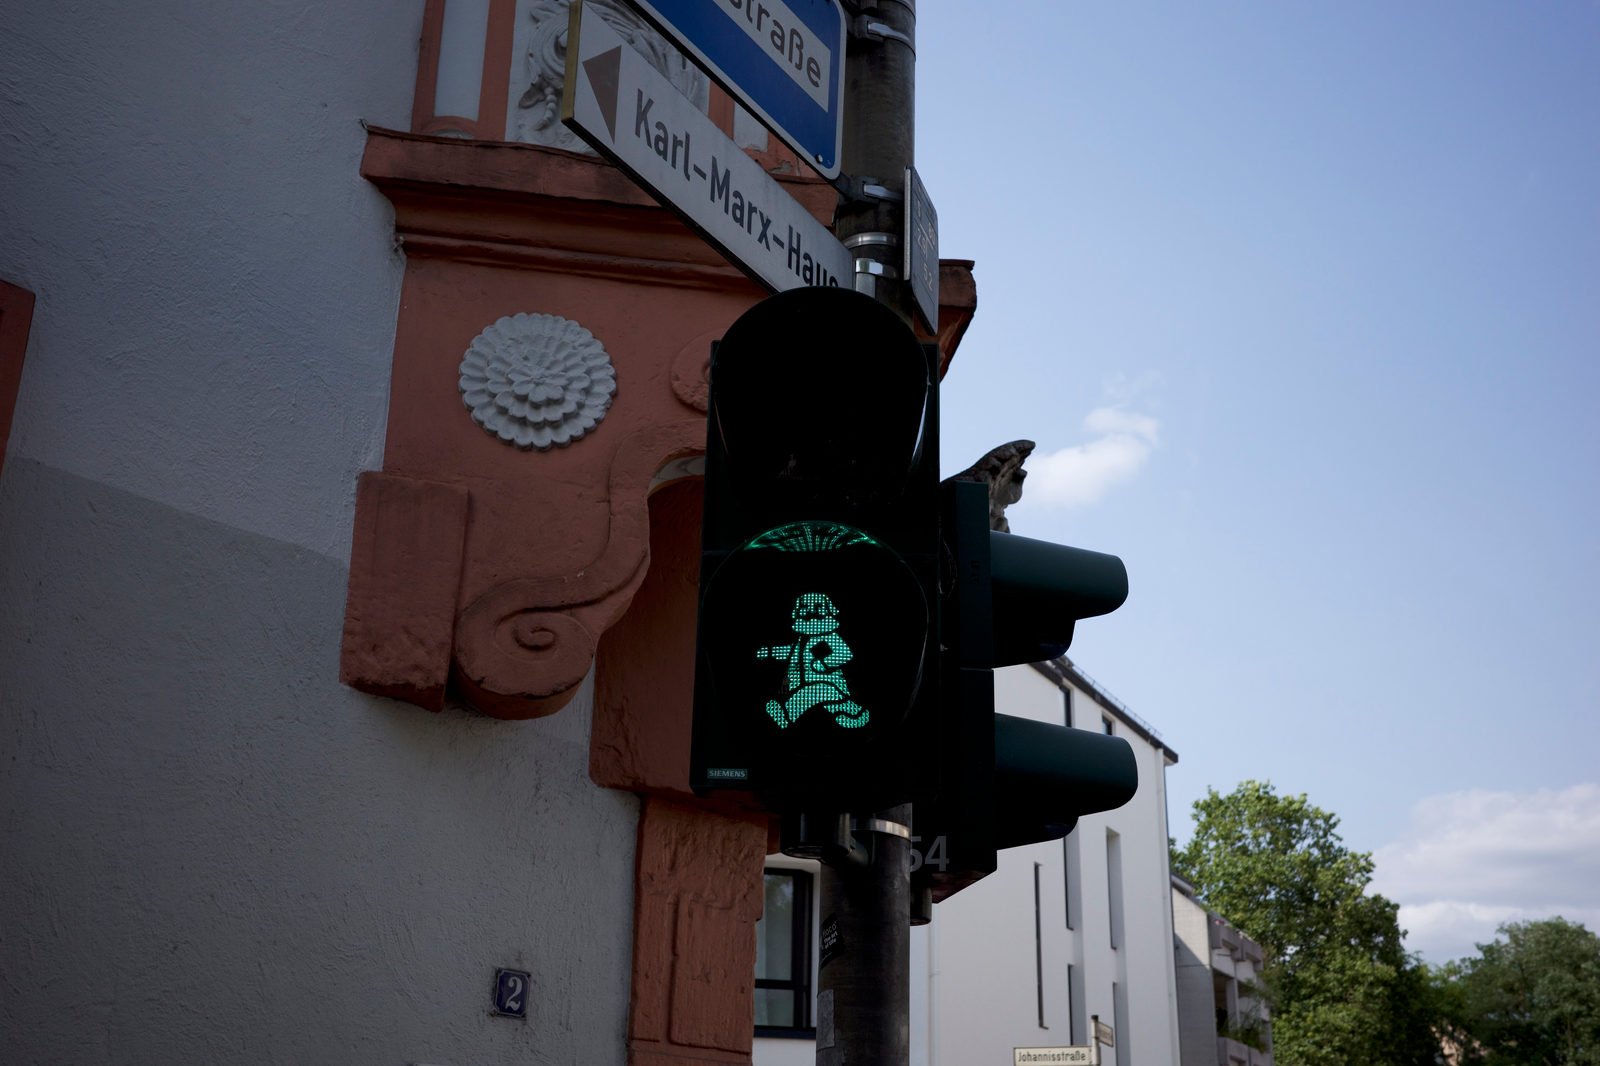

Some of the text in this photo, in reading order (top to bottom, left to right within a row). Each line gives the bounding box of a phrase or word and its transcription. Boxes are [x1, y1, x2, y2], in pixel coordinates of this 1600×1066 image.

[728, 0, 821, 88] traße
[708, 770, 746, 778] SIEMENS
[909, 835, 951, 873] 54
[504, 976, 523, 1011] 2
[1017, 1049, 1087, 1062] Johannisstraße
